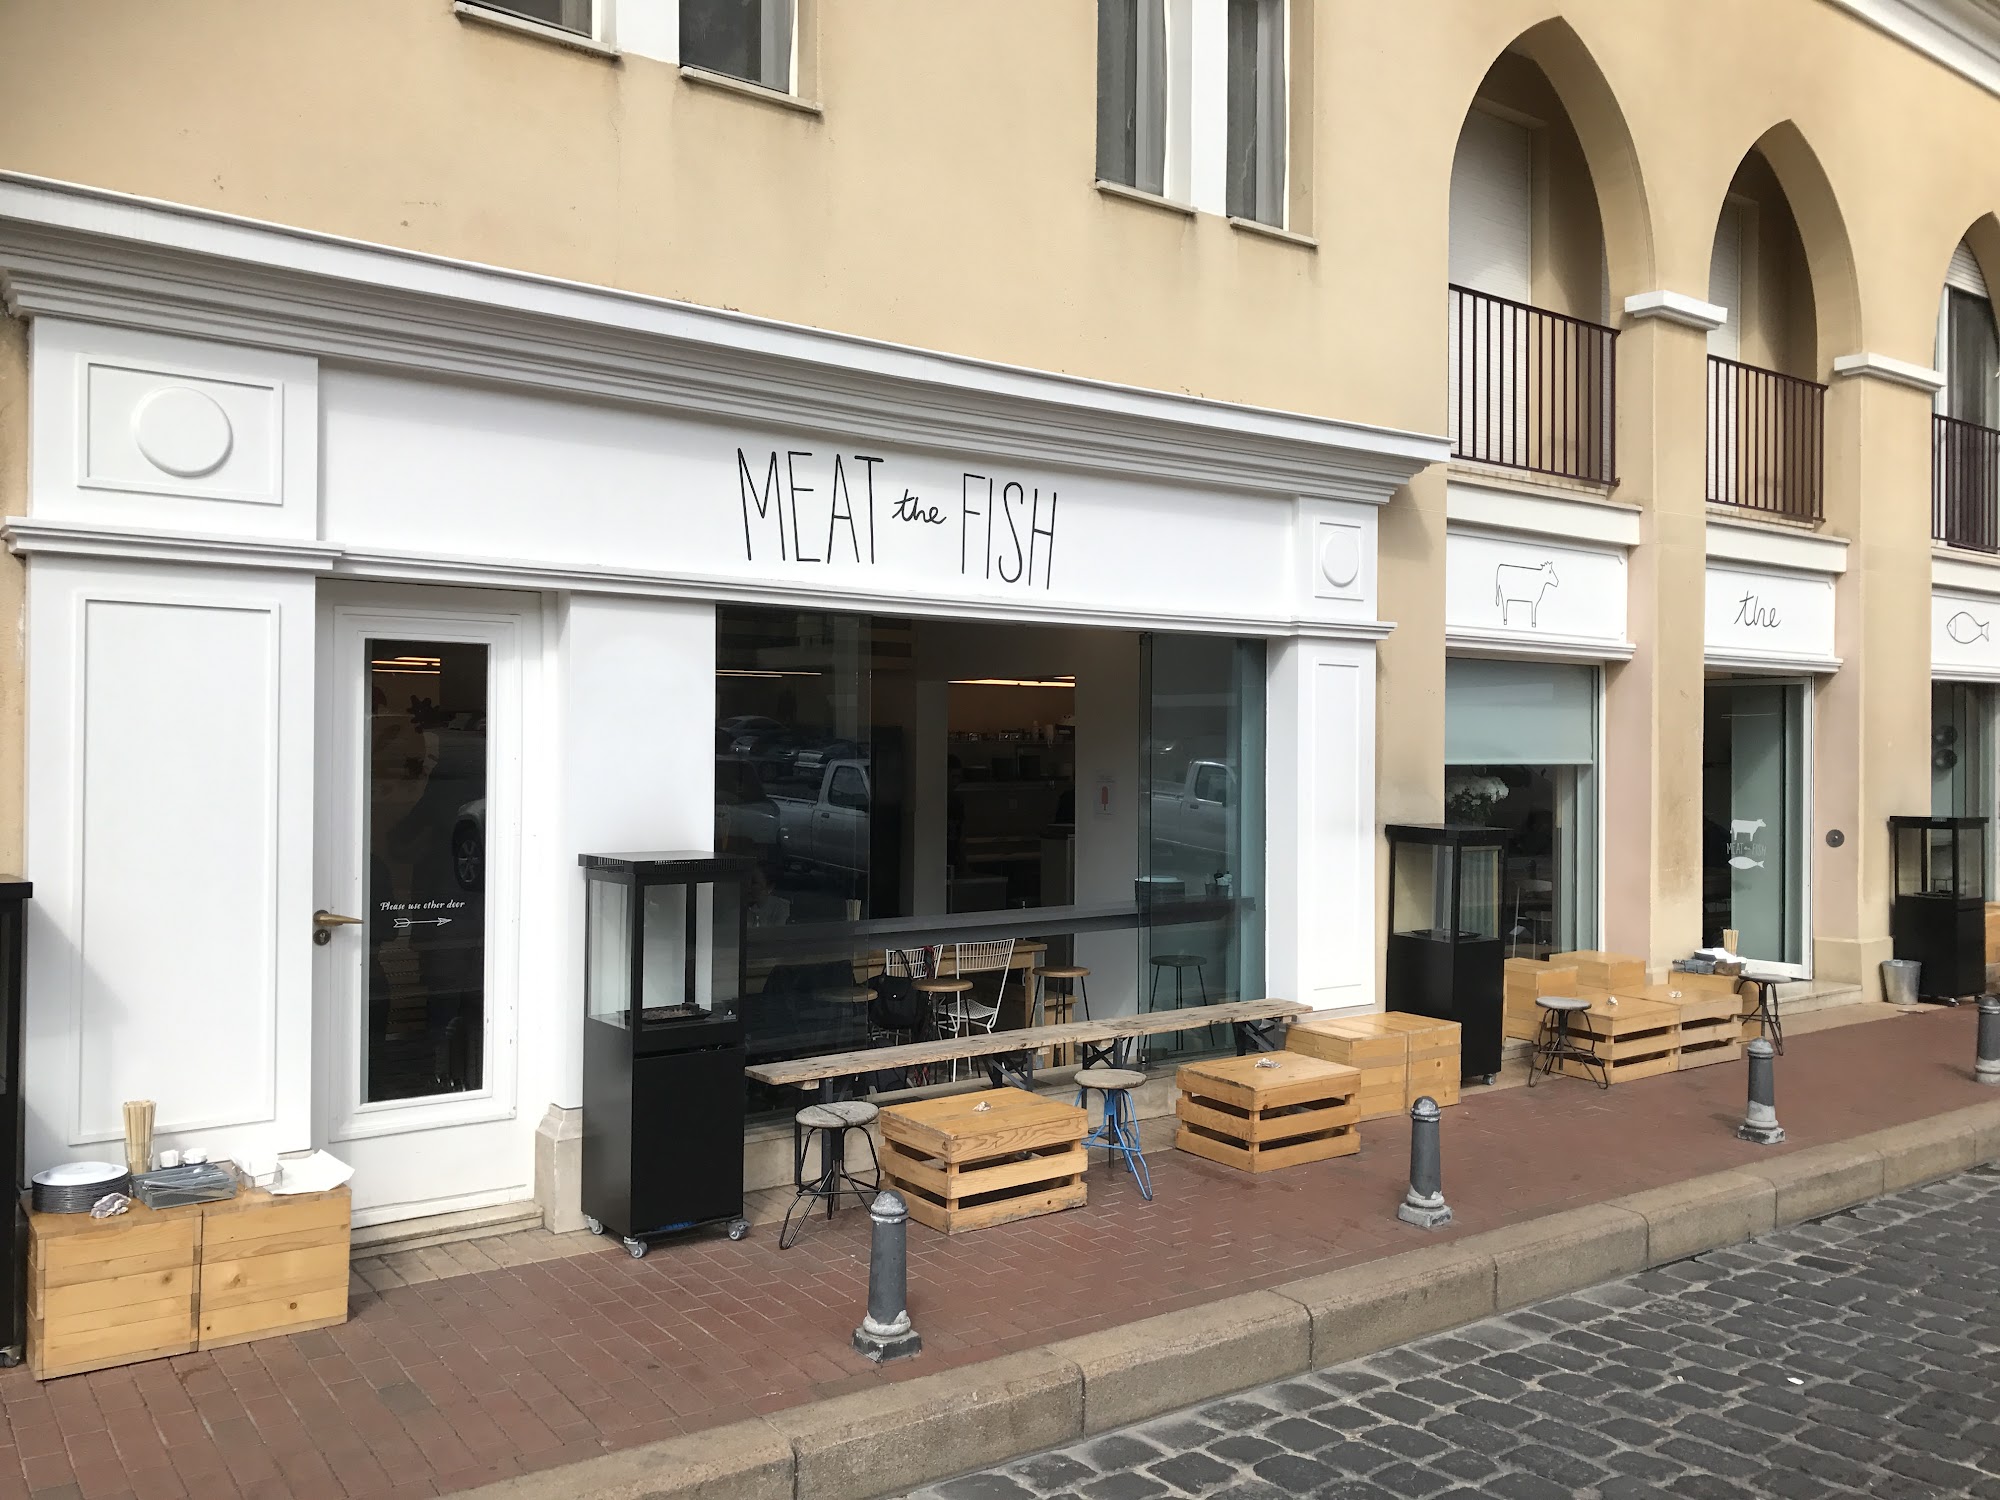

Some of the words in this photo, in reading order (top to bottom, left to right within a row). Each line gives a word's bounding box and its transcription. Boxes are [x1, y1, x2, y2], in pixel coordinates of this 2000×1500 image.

[738, 448, 884, 564] MEAT
[892, 489, 947, 524] the
[962, 472, 1057, 590] FISH
[1733, 590, 1782, 628] the
[1726, 842, 1744, 855] MEAT
[380, 901, 405, 911] Please
[423, 900, 445, 909] other
[446, 899, 465, 909] door
